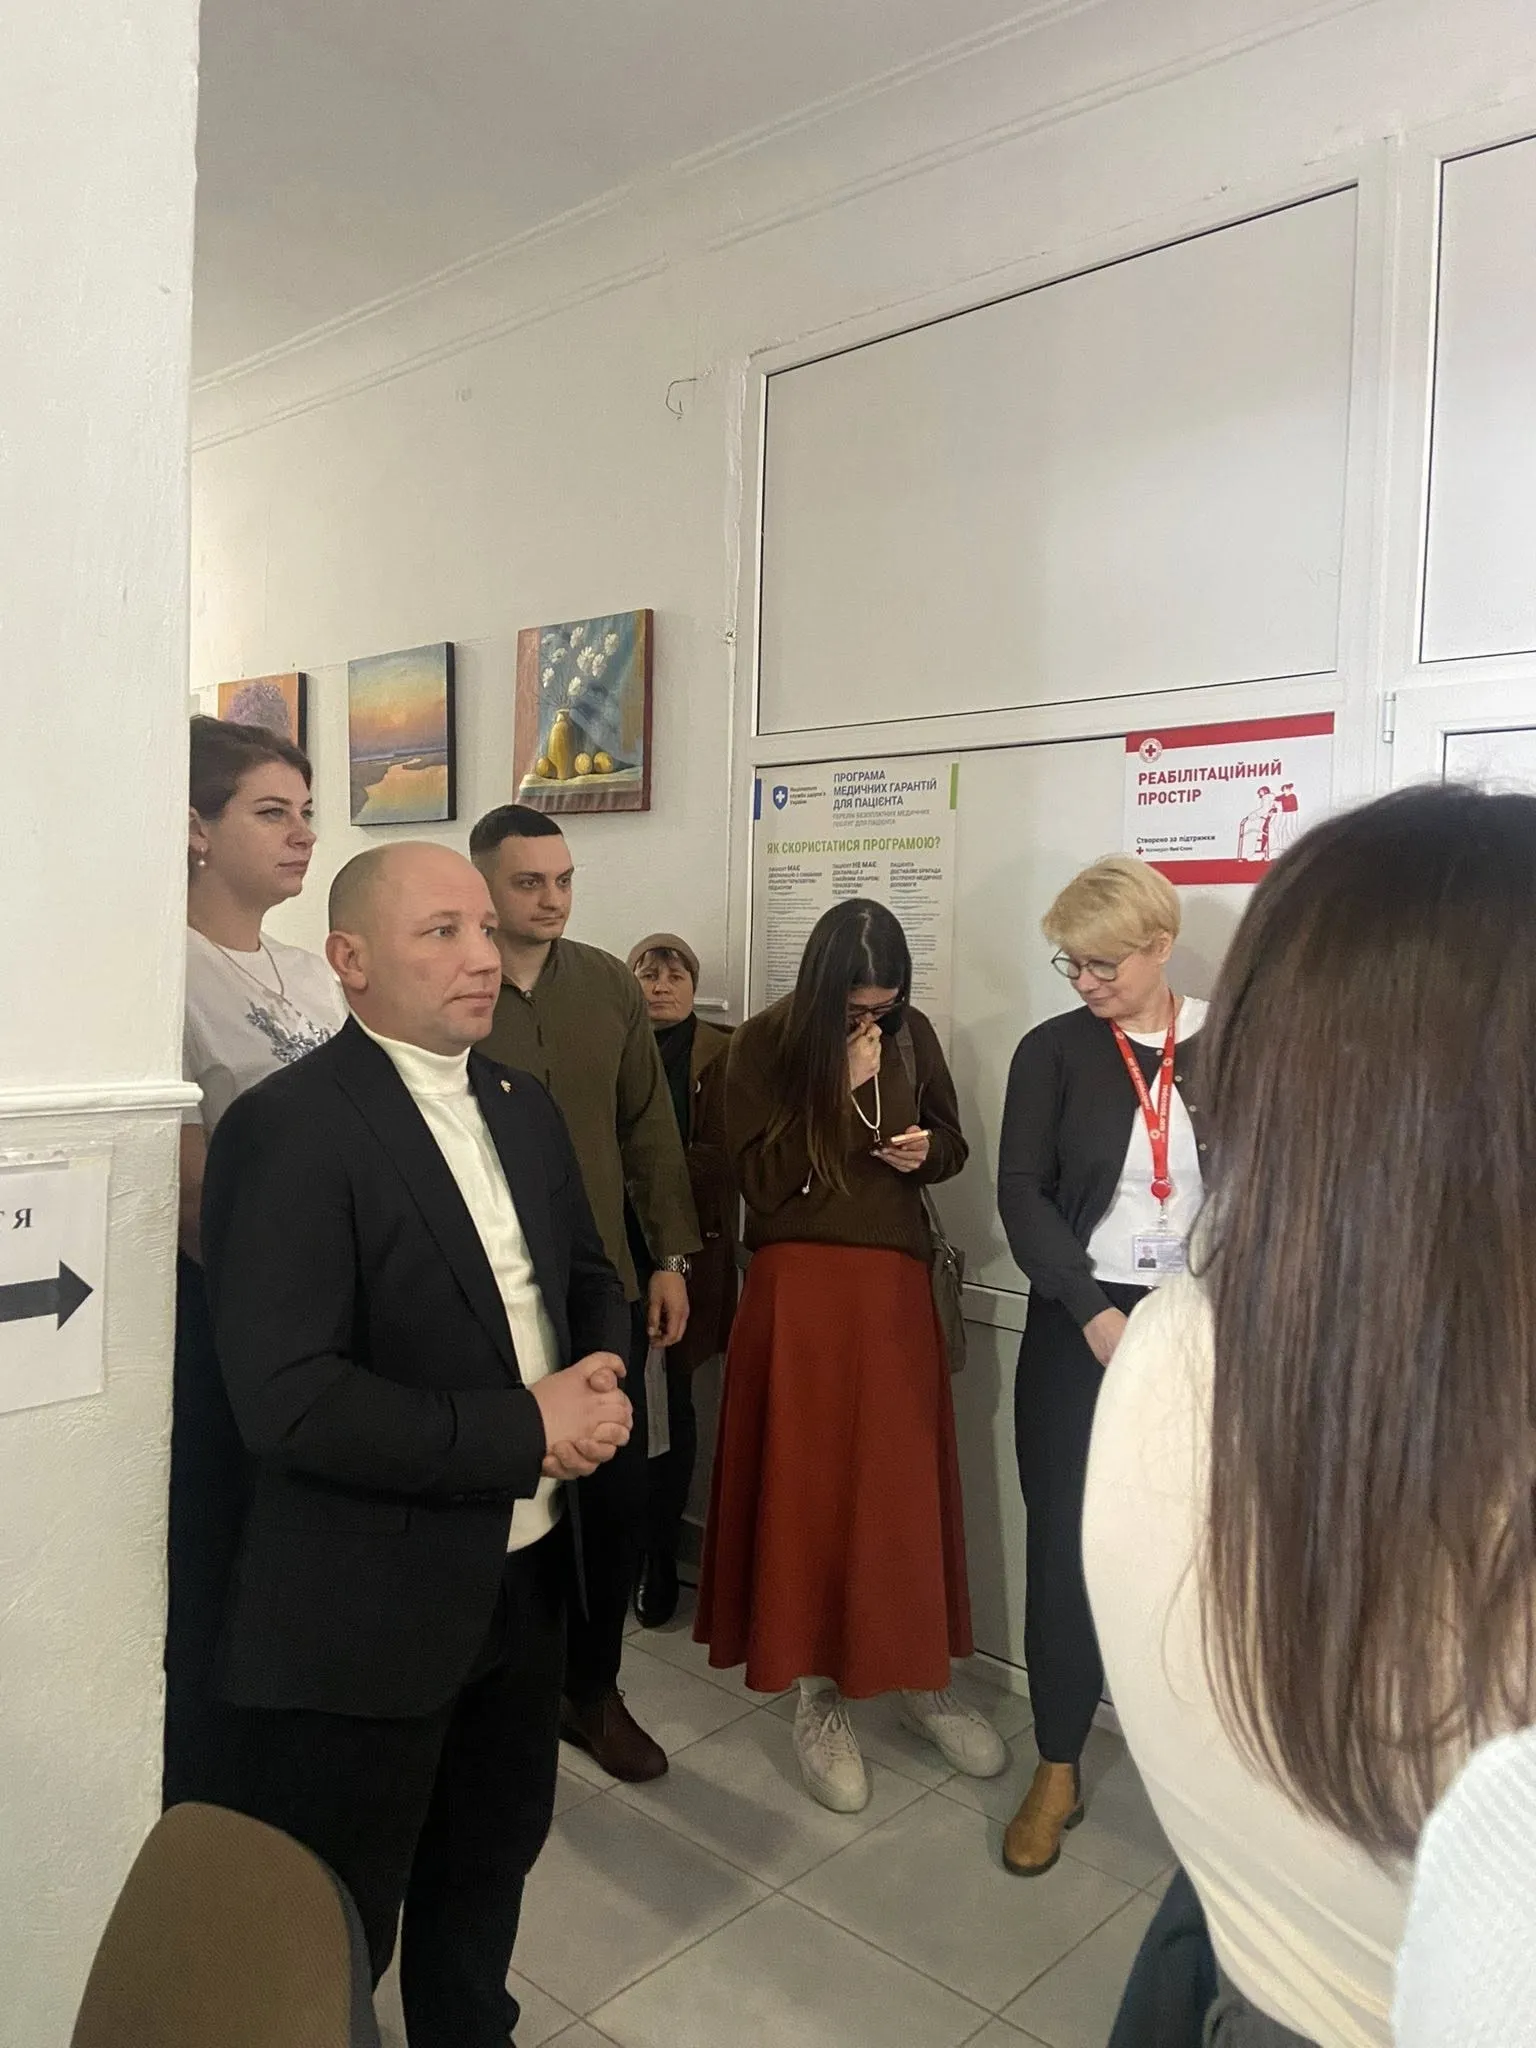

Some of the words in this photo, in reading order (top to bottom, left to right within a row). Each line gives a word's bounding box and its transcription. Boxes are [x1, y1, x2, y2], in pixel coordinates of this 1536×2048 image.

[833, 770, 886, 783] ПРОГРАМА
[1138, 759, 1282, 785] РЕАБІЛІТАЦІЙНИЙ
[833, 783, 887, 796] МЕДИЧНИХ
[889, 777, 937, 792] ГАРАНТІЙ
[832, 799, 853, 811] ДЛЯ
[854, 796, 904, 808] ПАЦІЄНТА
[1137, 789, 1201, 806] ПРОСТІР
[767, 842, 780, 854] ЯК
[781, 840, 860, 853] СКОРИСТАТИСЯ
[862, 836, 941, 850] ПРОГРАМОЮ?
